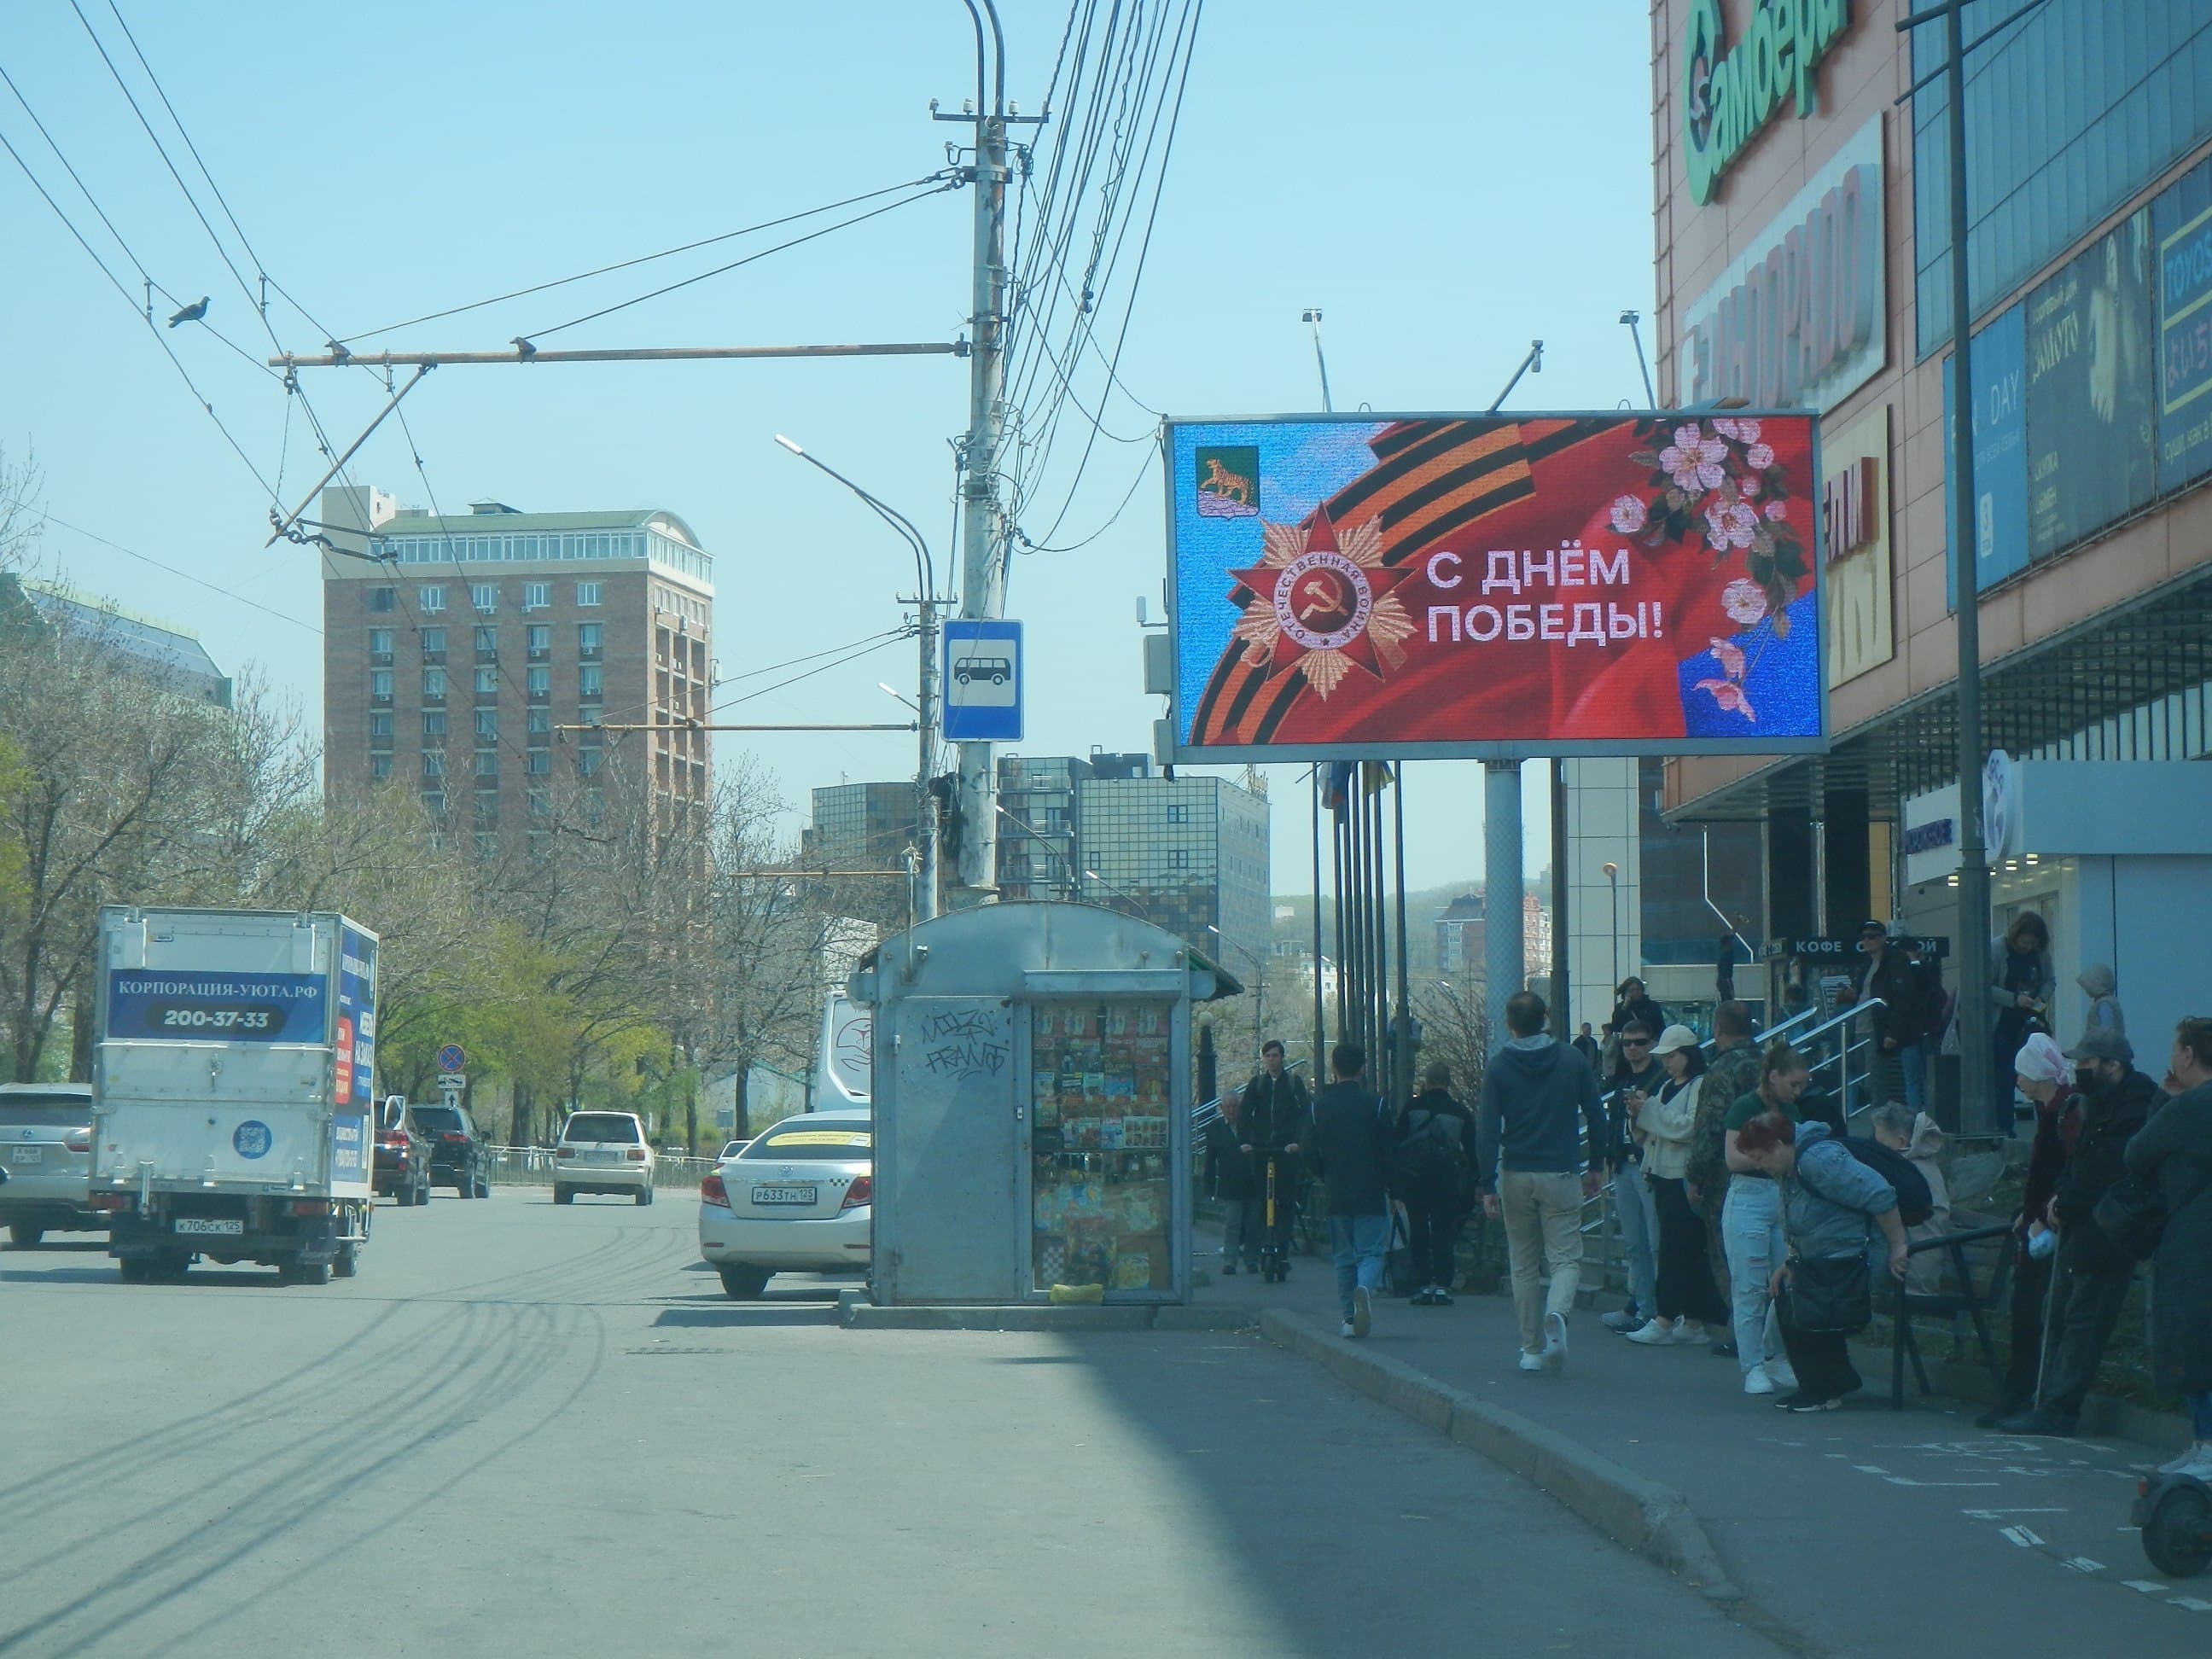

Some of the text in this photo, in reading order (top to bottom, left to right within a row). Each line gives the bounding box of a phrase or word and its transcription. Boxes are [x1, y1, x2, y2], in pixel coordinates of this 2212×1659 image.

[1991, 368, 2019, 425] DAY
[1427, 539, 1629, 595] С ДНЁМ
[1278, 556, 1359, 639] ОТЕЧЕСТВЕННАЯ
[1428, 601, 1662, 647] ПОБЕДЫ!
[1796, 941, 1842, 952] КОФЕ
[119, 981, 317, 998] КОРПОРАЦИЯ-УЮТА.РФ
[164, 1010, 269, 1027] 200-37-33
